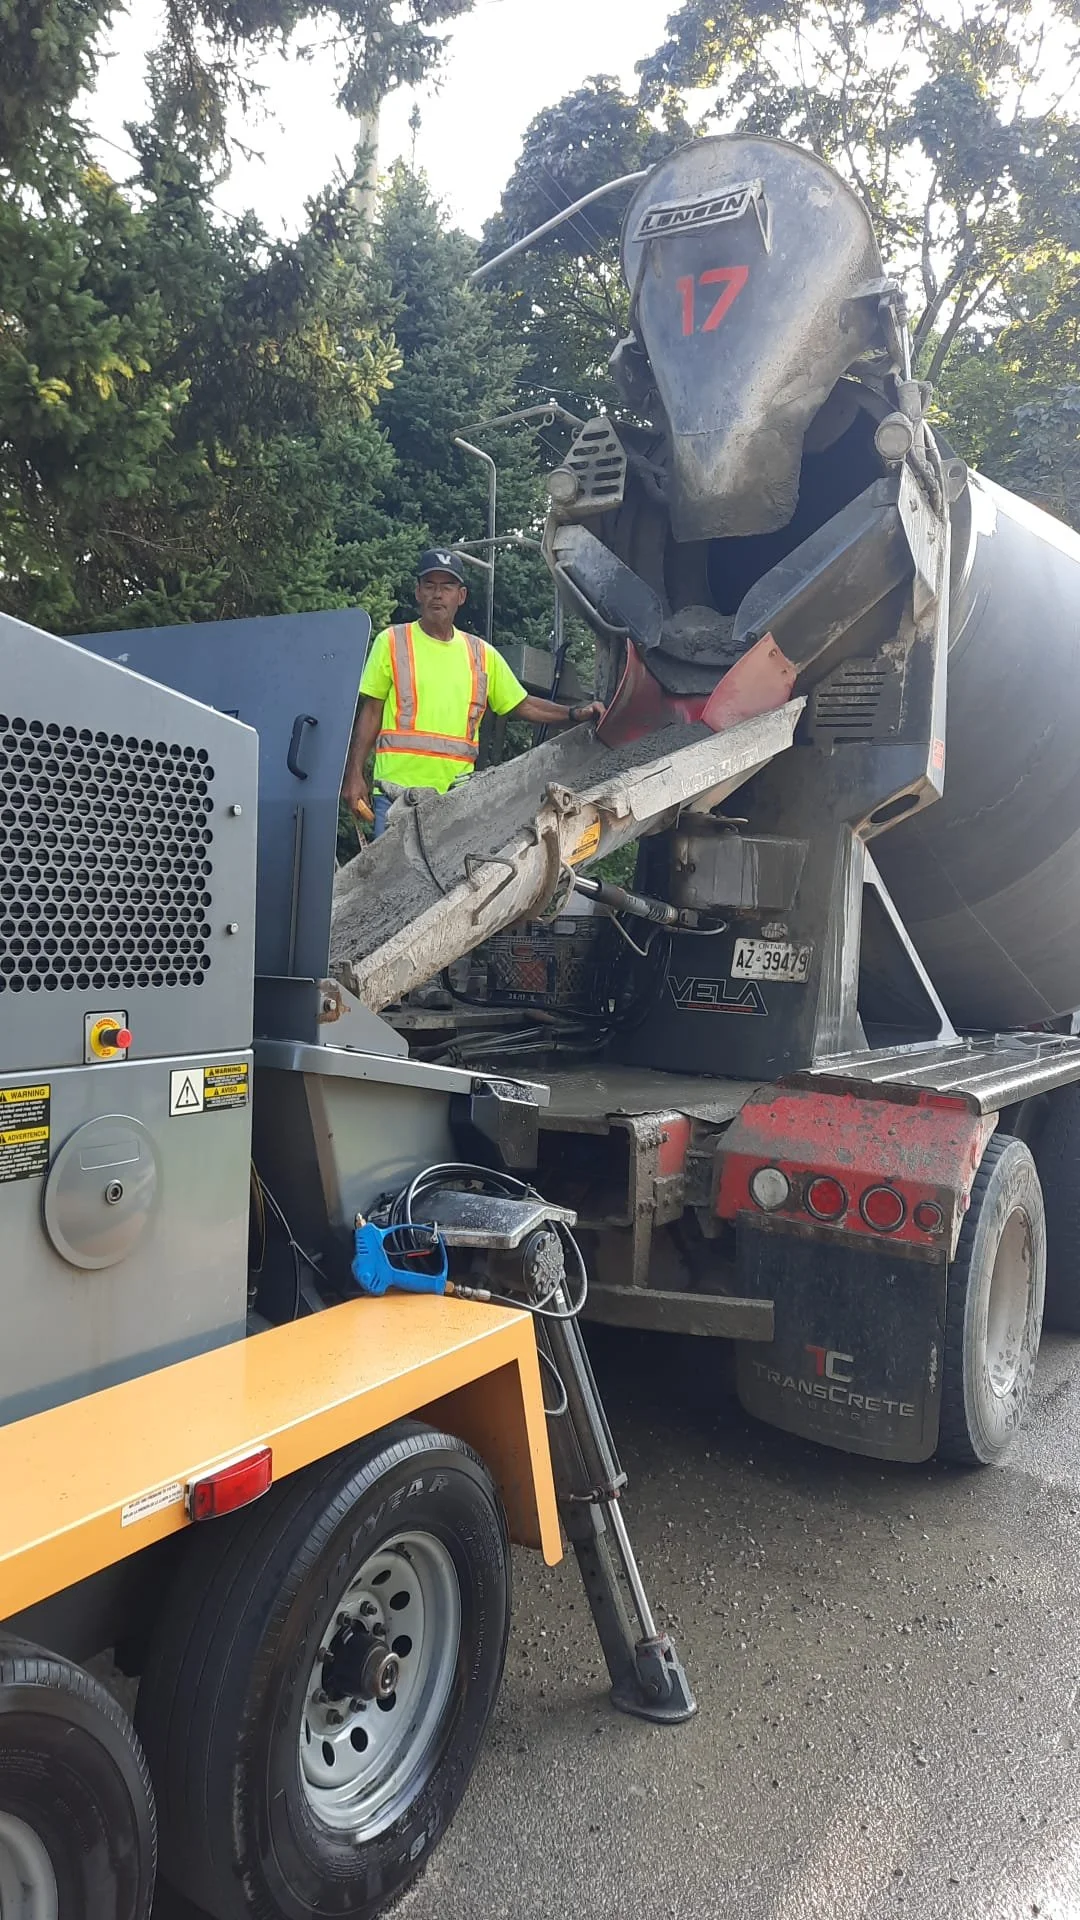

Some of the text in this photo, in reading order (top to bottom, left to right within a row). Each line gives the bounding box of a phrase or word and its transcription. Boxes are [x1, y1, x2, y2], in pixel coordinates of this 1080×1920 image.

[676, 265, 749, 337] 17
[667, 976, 768, 1016] VELA
[10, 1088, 46, 1100] WARNING
[7, 1130, 47, 1141] ADVERTENCIA
[752, 1360, 916, 1418] TRANSCRETE
